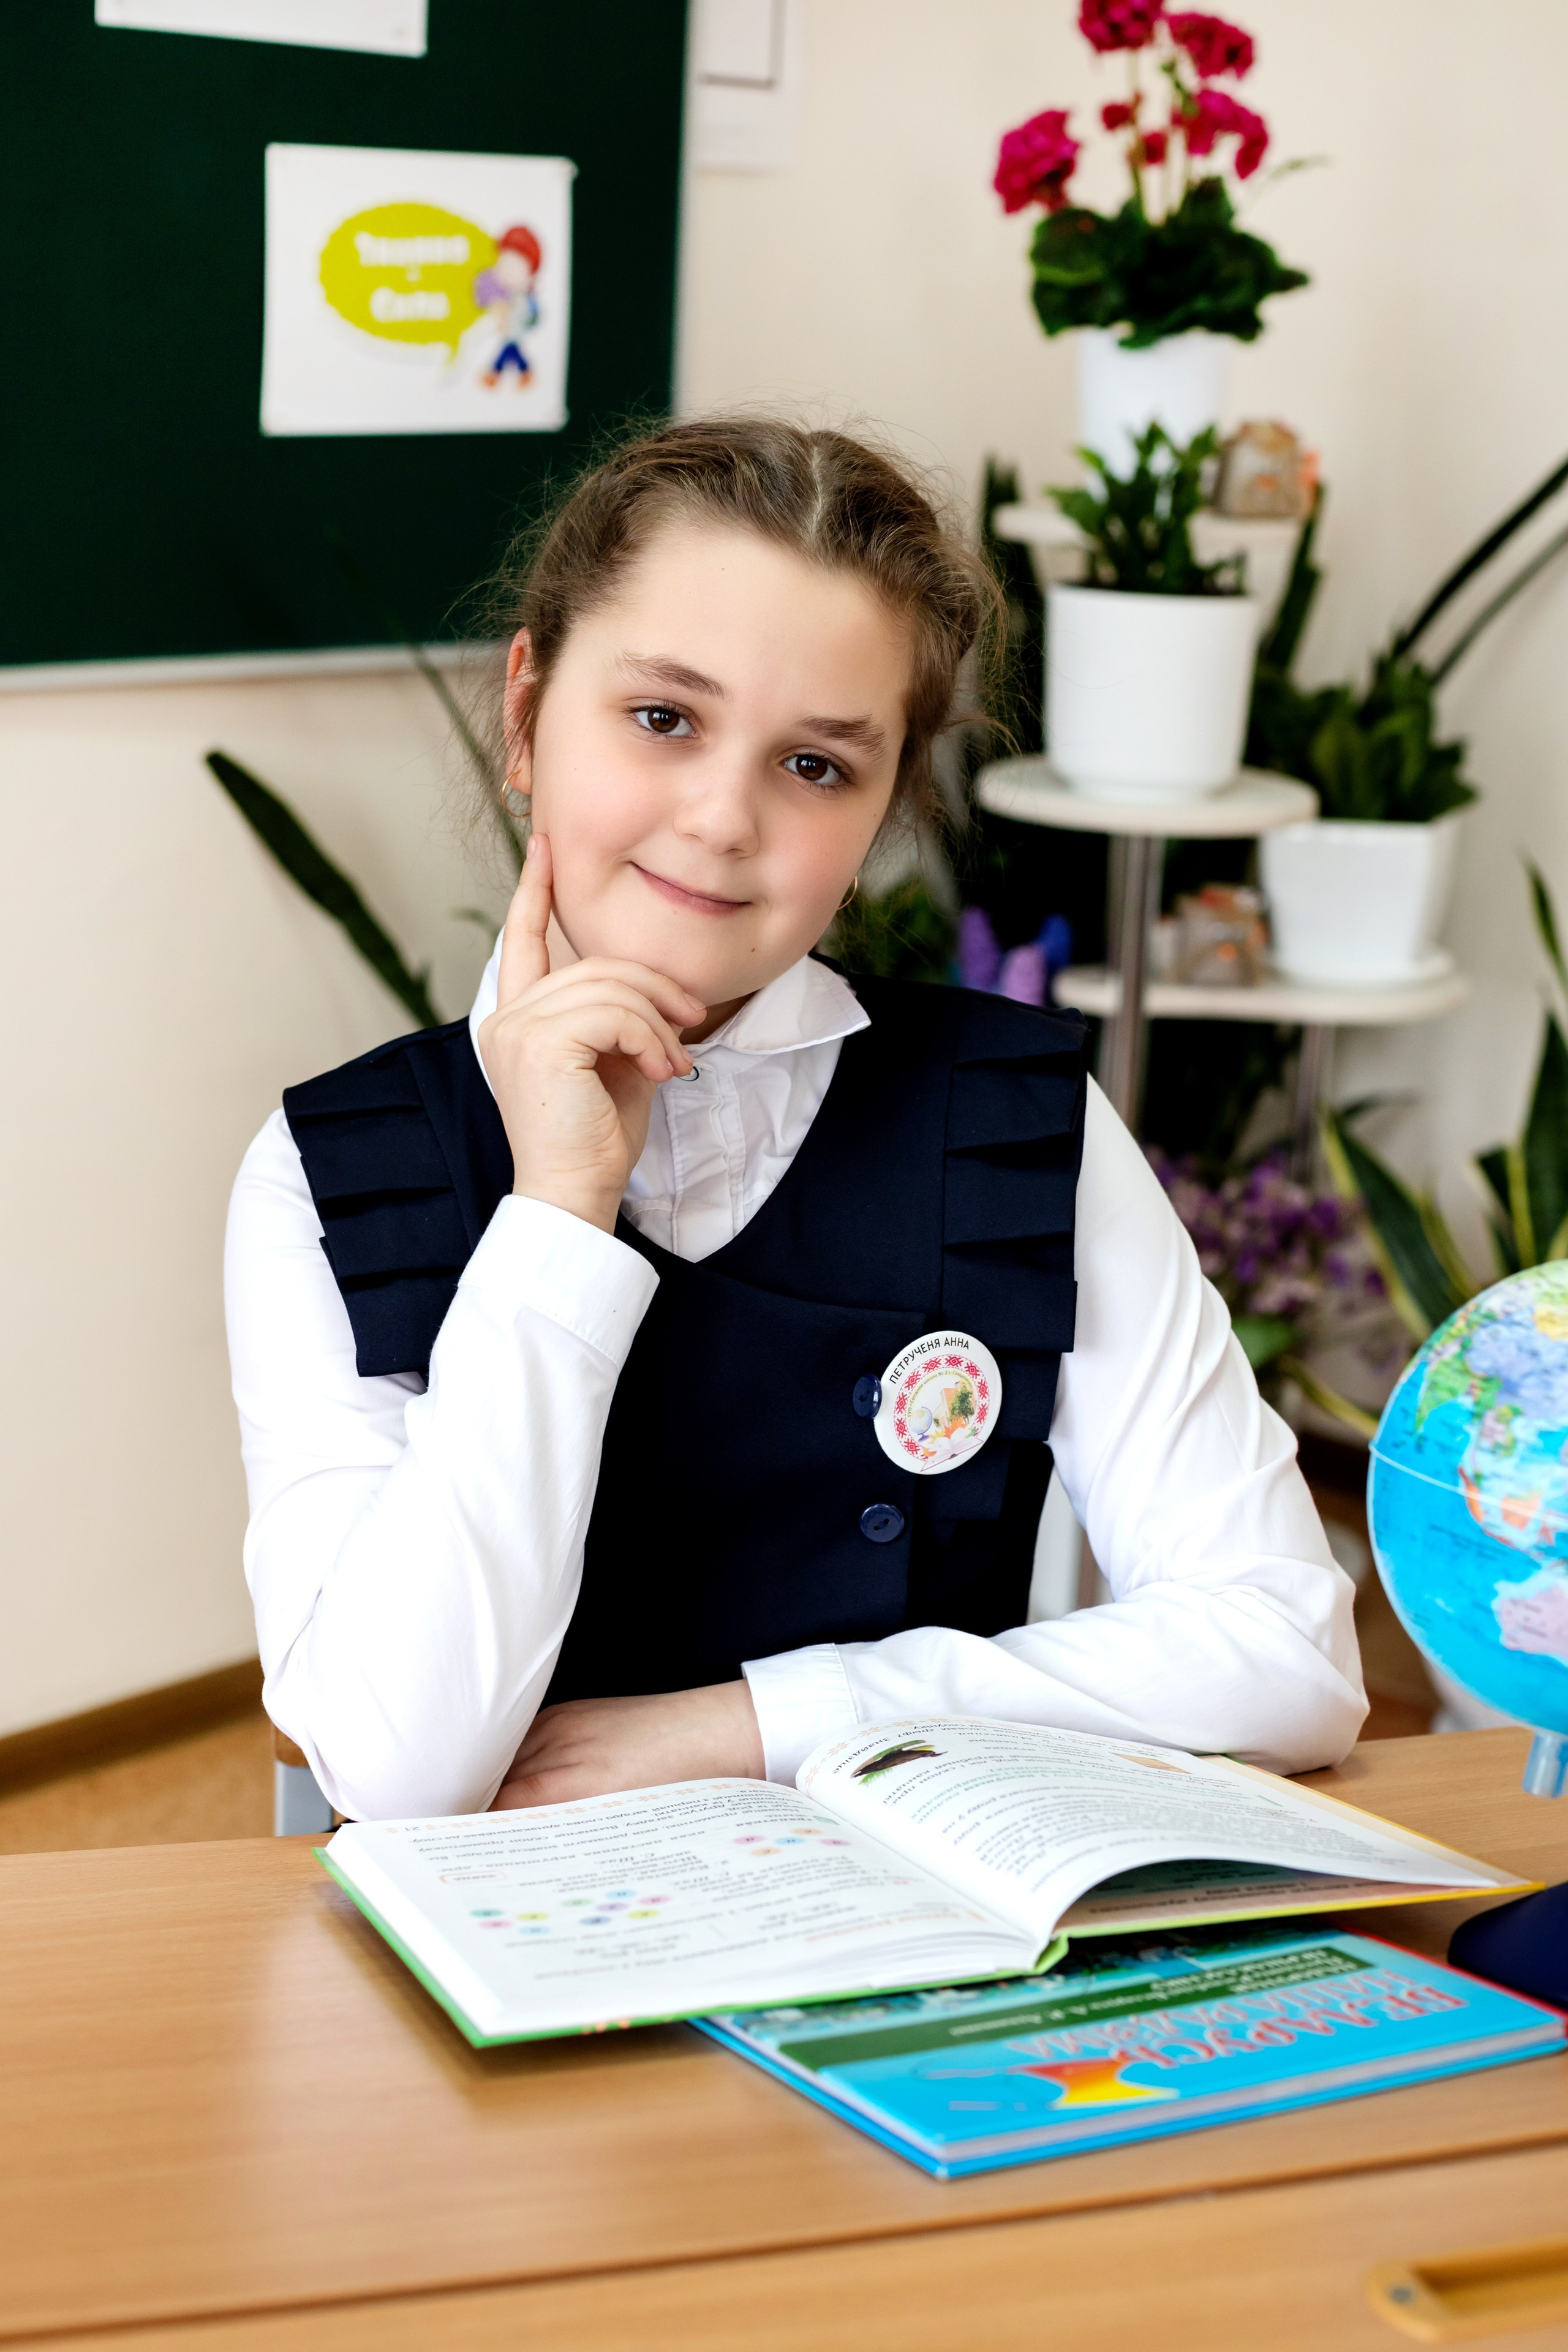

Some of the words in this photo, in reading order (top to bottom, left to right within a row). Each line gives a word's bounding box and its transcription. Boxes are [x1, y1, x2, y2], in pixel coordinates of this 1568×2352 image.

[889, 1338, 941, 1384] ПЕТРУЧЕНЯ
[944, 1337, 970, 1350] АННА
[897, 1728, 934, 1738] грыф?
[833, 1737, 891, 1774] Знайдзіце
[919, 1767, 956, 1784] склон
[883, 1770, 930, 1804] канчаткі
[650, 1803, 707, 1817] канчаткі.
[652, 1800, 701, 1811] першай
[679, 1804, 725, 1816] другую
[606, 1810, 649, 1820] загадкі
[623, 1815, 674, 1826] загадку.
[662, 1812, 737, 1829] прыметнікі,
[463, 1825, 560, 1838] аднакаранёвае
[554, 1825, 619, 1838] Вызначце
[415, 1841, 504, 1852] прыметнікаў.
[563, 1833, 627, 1847] дапамаглі
[509, 1845, 558, 1854] знайсці
